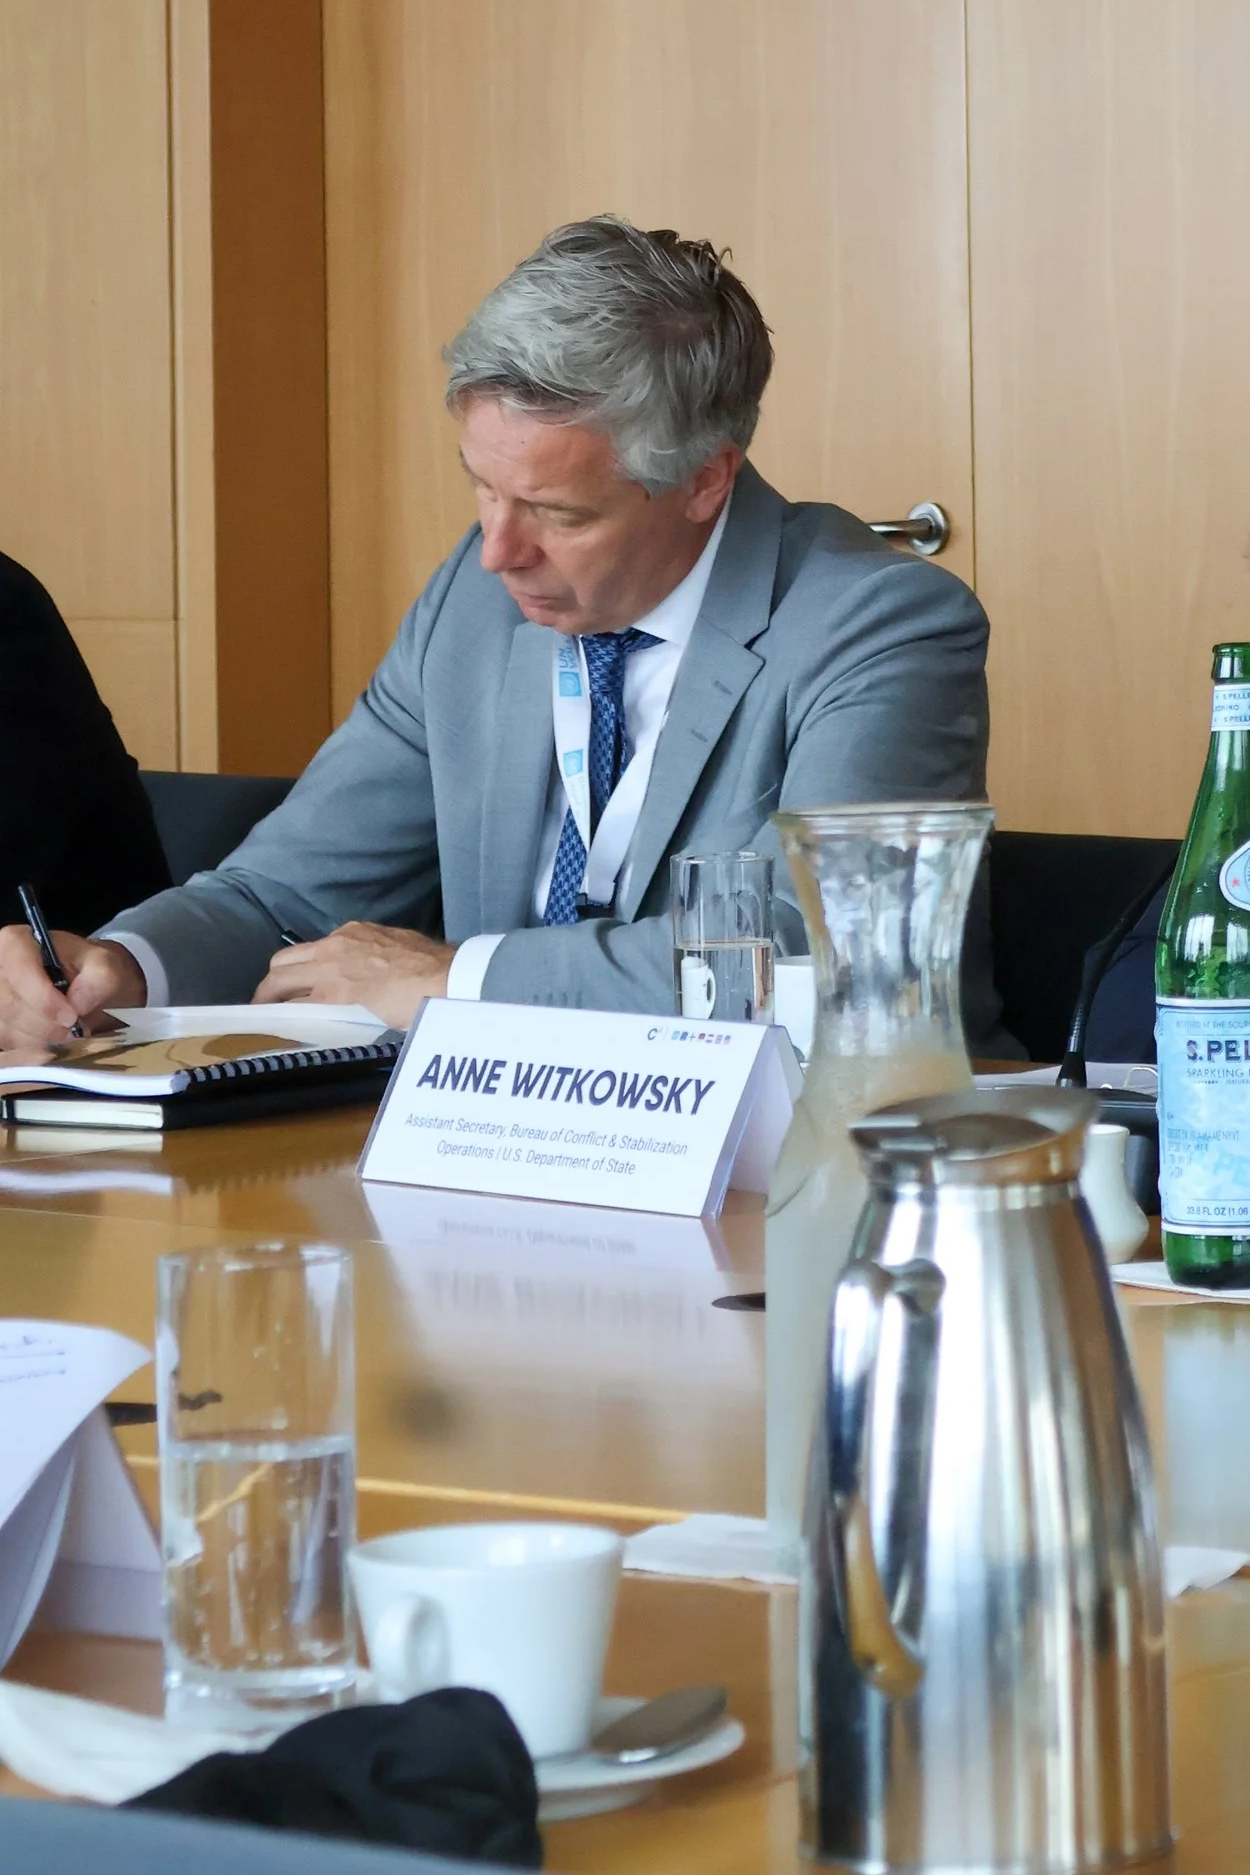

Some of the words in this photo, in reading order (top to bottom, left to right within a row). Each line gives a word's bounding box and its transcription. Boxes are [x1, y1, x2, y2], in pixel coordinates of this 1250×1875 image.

[416, 1054, 507, 1095] ANNE
[511, 1062, 716, 1115] WITKOWSKY
[1187, 1067, 1244, 1078] SPARKLING
[405, 1113, 454, 1131] Assistant
[455, 1117, 507, 1139] Secretary,
[509, 1123, 549, 1141] Bureau
[550, 1128, 565, 1142] of
[564, 1129, 607, 1147] Conflict
[608, 1134, 618, 1148] &
[619, 1135, 688, 1156] Stabilization
[437, 1139, 494, 1159] Operations
[502, 1147, 523, 1162] U.S.
[526, 1149, 591, 1170] Department
[591, 1157, 606, 1171] of
[606, 1158, 636, 1175] State
[1186, 1206, 1201, 1215] 33.8
[1202, 1207, 1213, 1216] FL
[1214, 1207, 1226, 1216] OZ
[1228, 1207, 1249, 1217] (1.06
